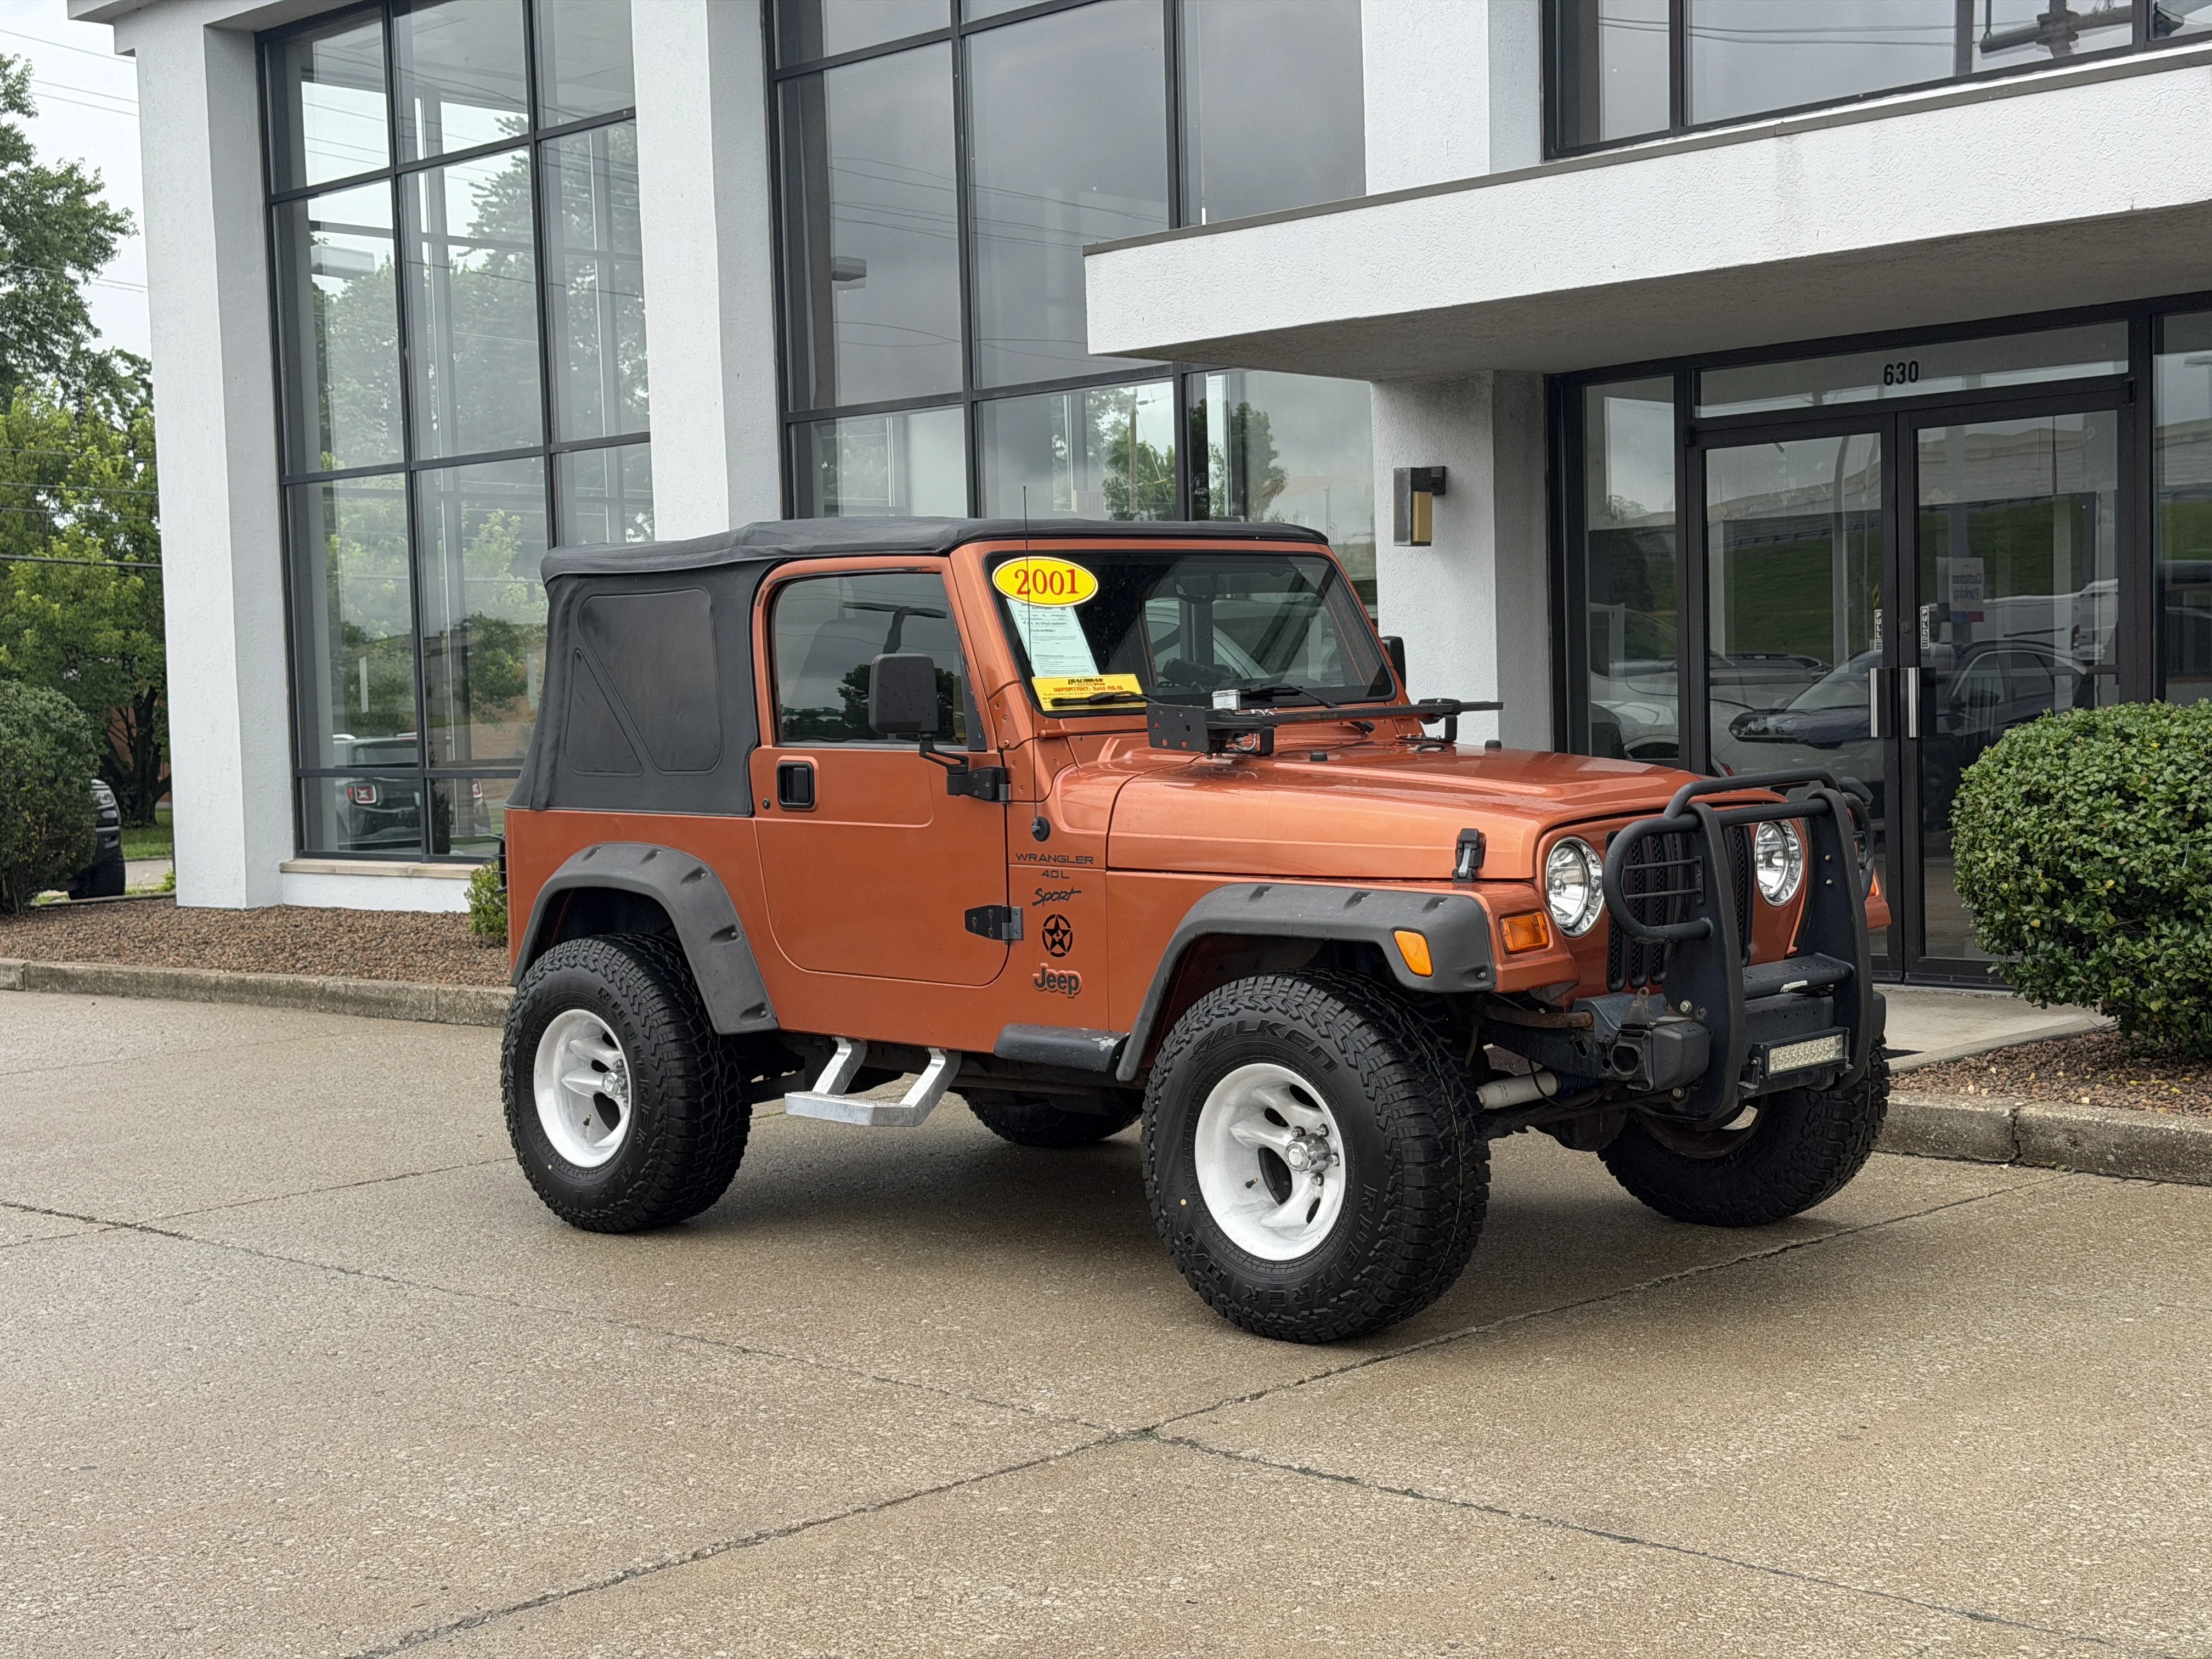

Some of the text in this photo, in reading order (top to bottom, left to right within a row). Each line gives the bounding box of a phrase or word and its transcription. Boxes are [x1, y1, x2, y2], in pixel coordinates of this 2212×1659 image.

[1883, 360, 1919, 386] 630
[1014, 568, 1080, 596] 2001
[1015, 852, 1094, 865] WRANGLER
[1032, 963, 1080, 996] Jeep
